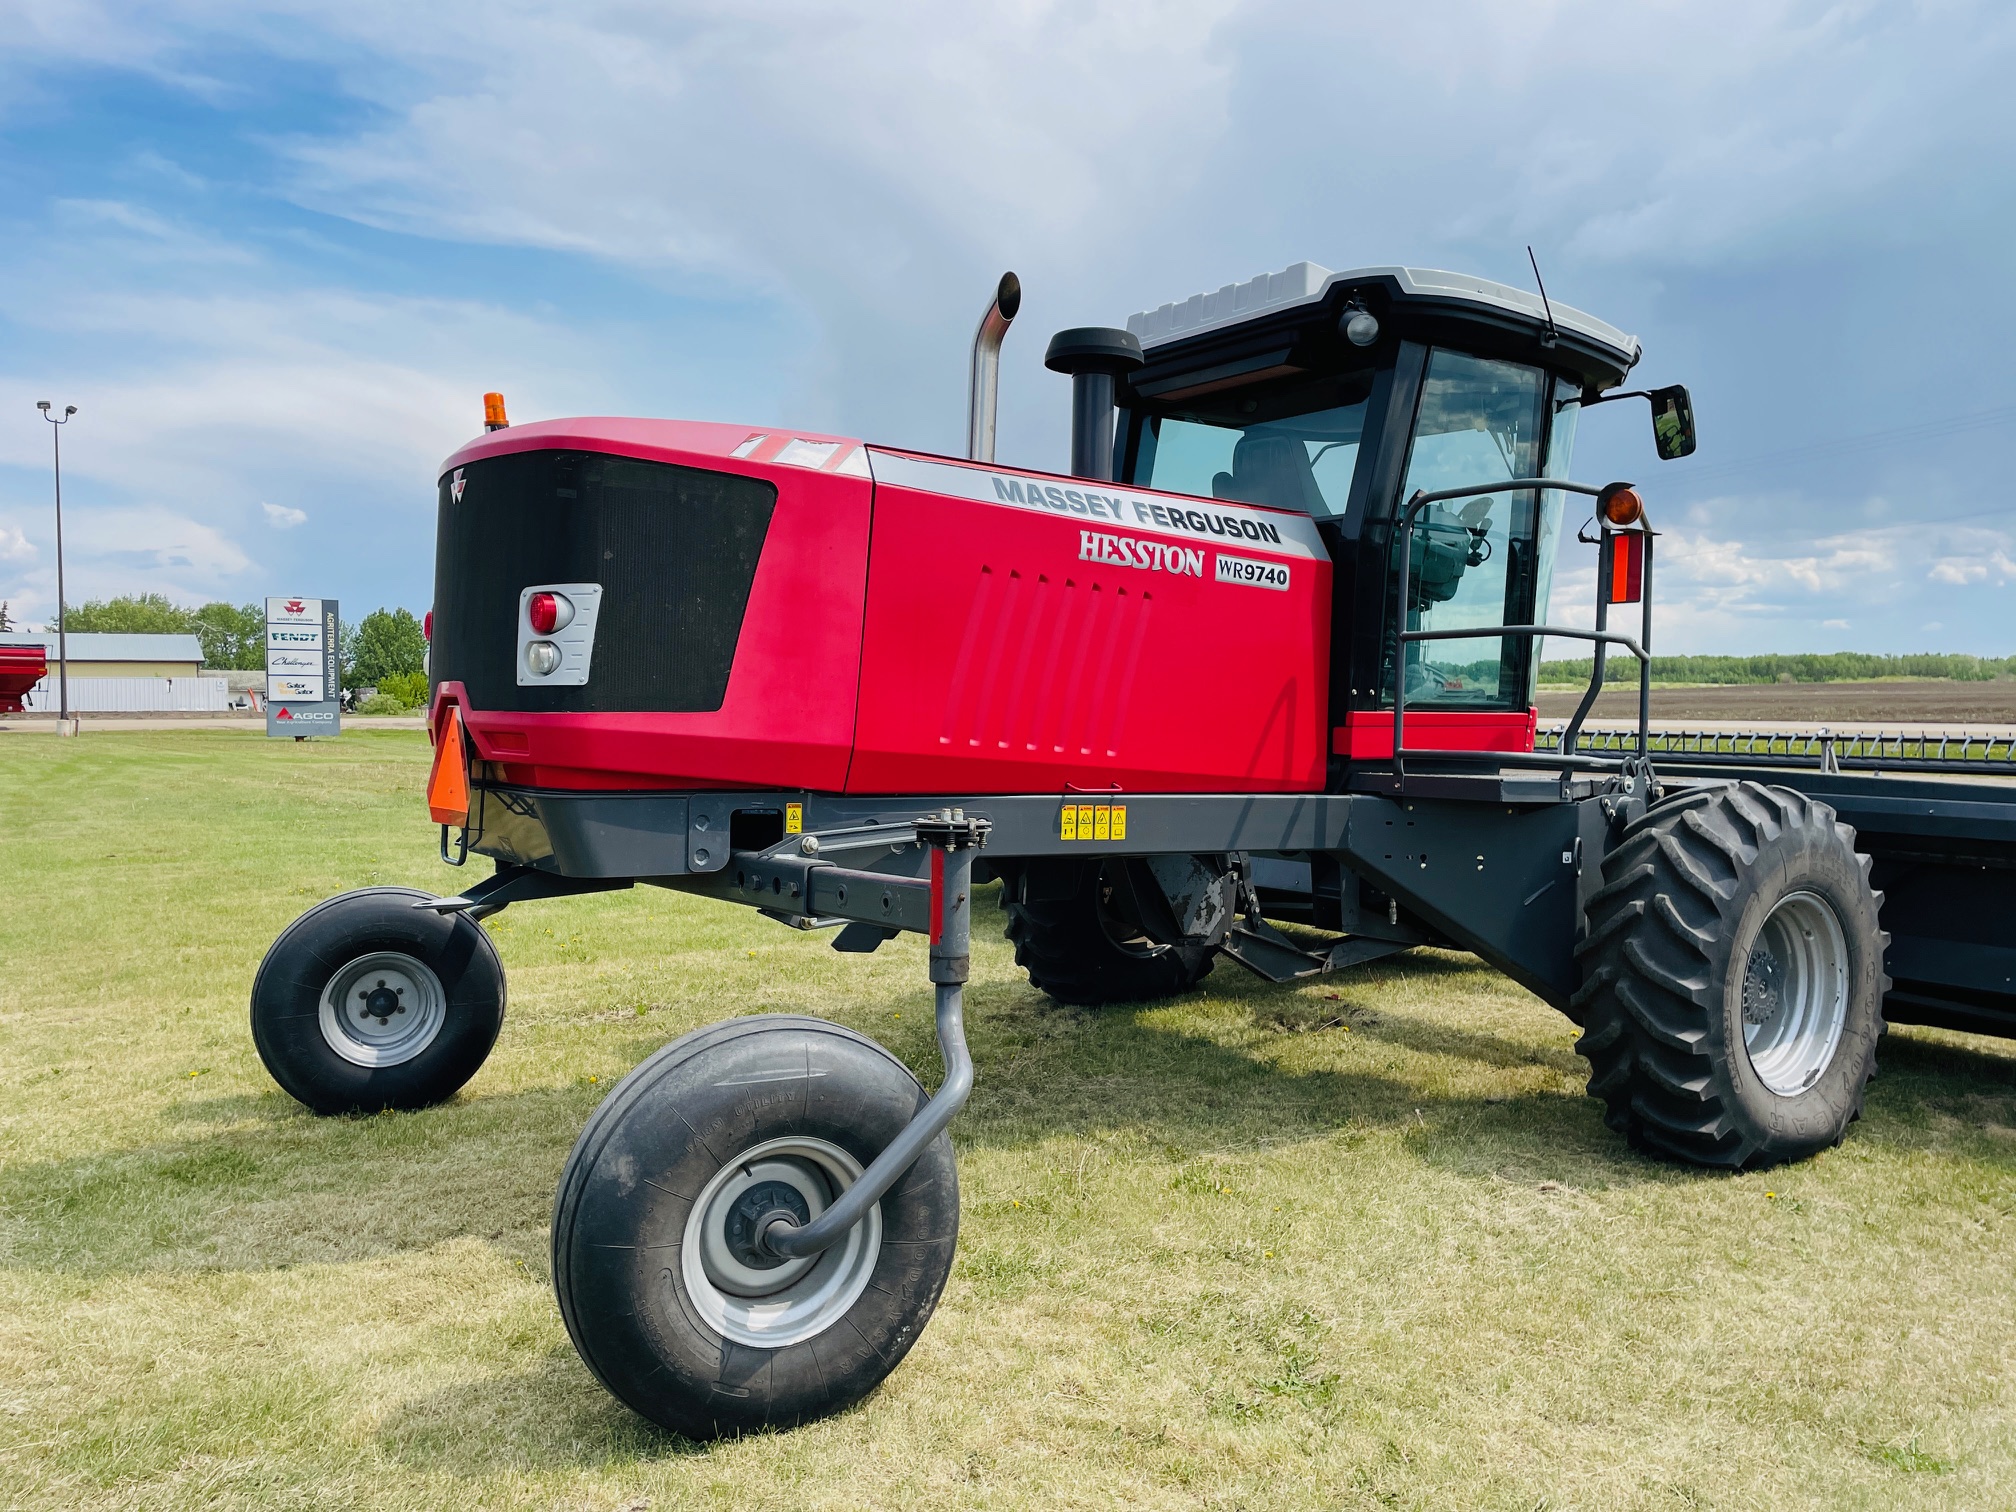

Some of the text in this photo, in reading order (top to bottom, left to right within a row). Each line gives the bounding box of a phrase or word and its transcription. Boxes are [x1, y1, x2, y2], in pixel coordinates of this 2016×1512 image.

[991, 477, 1281, 544] MASSEY FERGUSON
[1079, 530, 1205, 578] HESSTON
[1218, 558, 1288, 586] WR9740
[271, 632, 319, 642] FENDT
[272, 656, 317, 669] Challenger
[326, 612, 336, 699] AGRITERRA EQUIPMENT
[293, 712, 334, 720] AGCO
